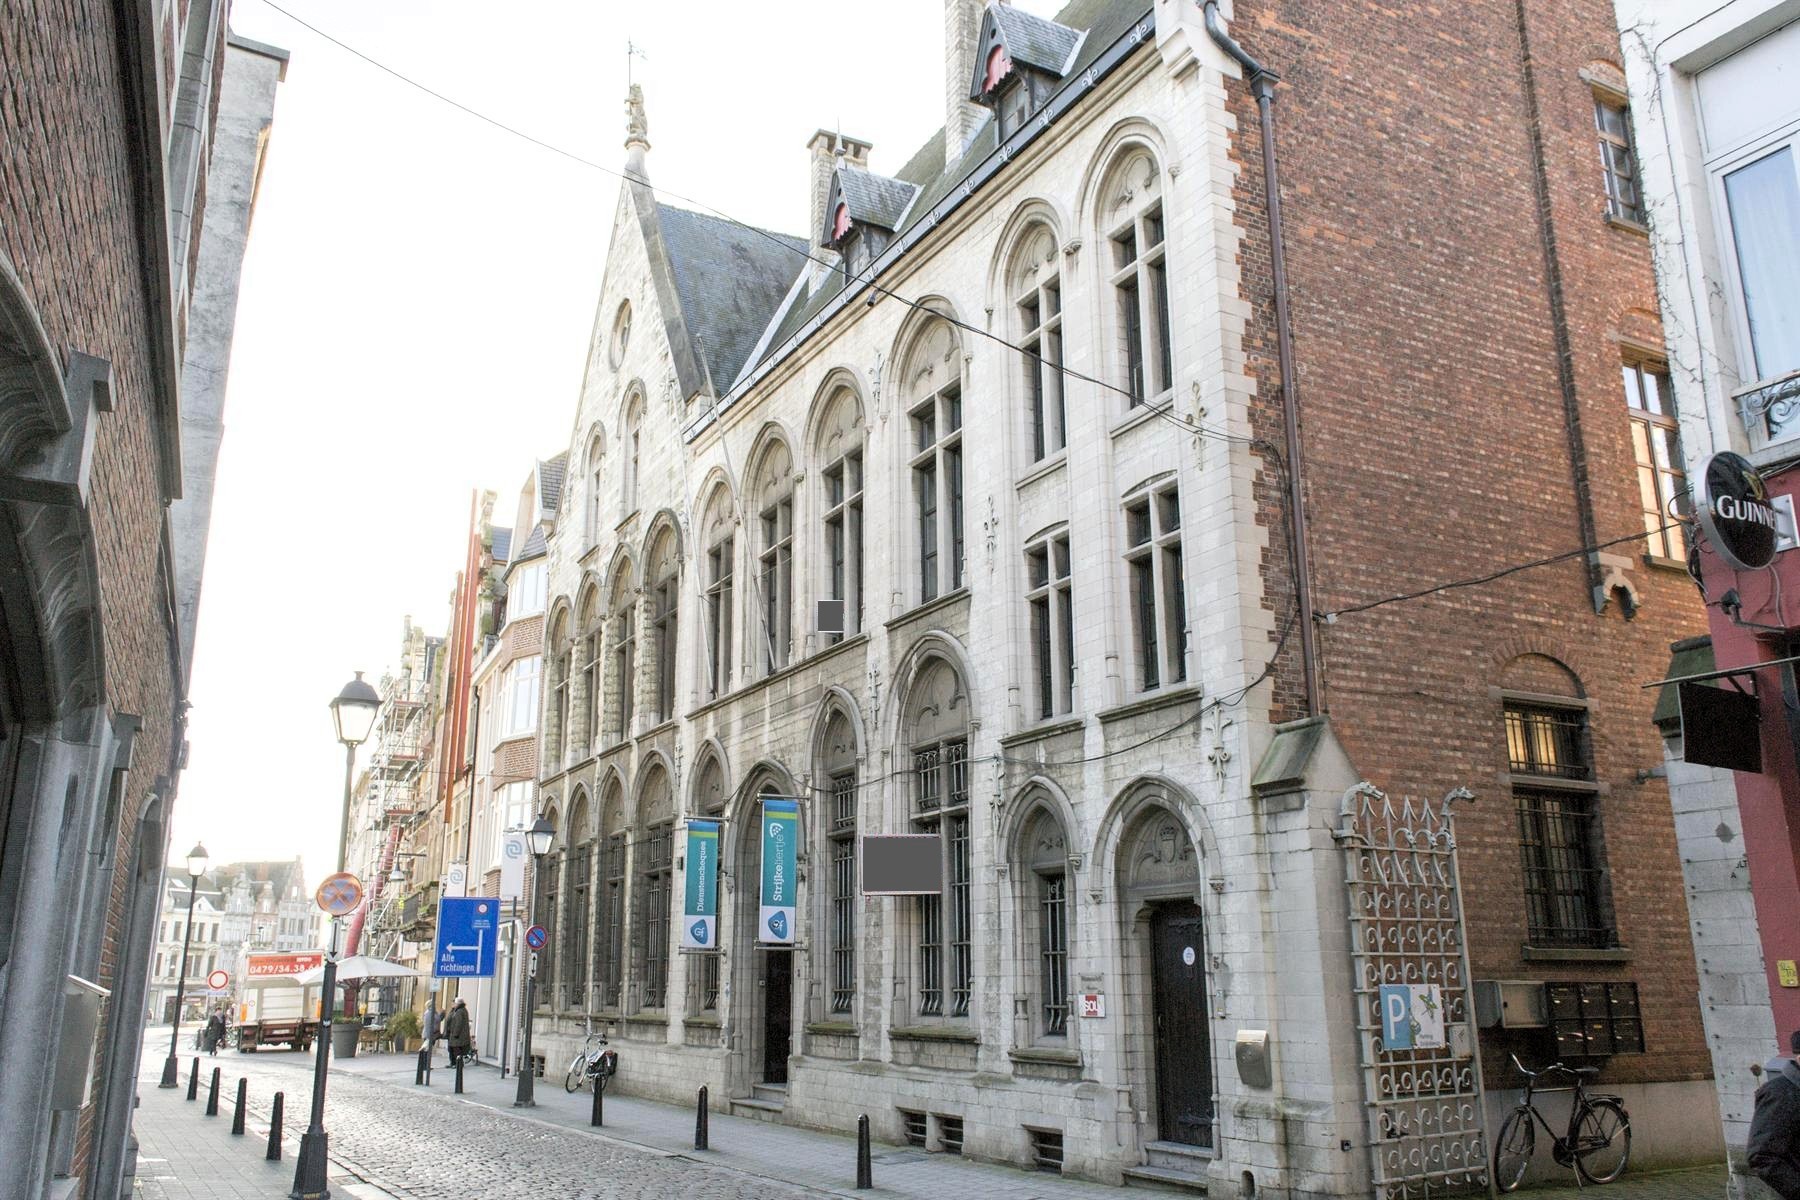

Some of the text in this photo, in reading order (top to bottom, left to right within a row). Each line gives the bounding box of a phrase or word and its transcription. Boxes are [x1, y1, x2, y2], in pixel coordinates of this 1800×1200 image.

[696, 840, 707, 912] Dienstencheques
[440, 963, 475, 973] richtingen
[441, 953, 455, 962] Alle
[1387, 994, 1405, 1040] P
